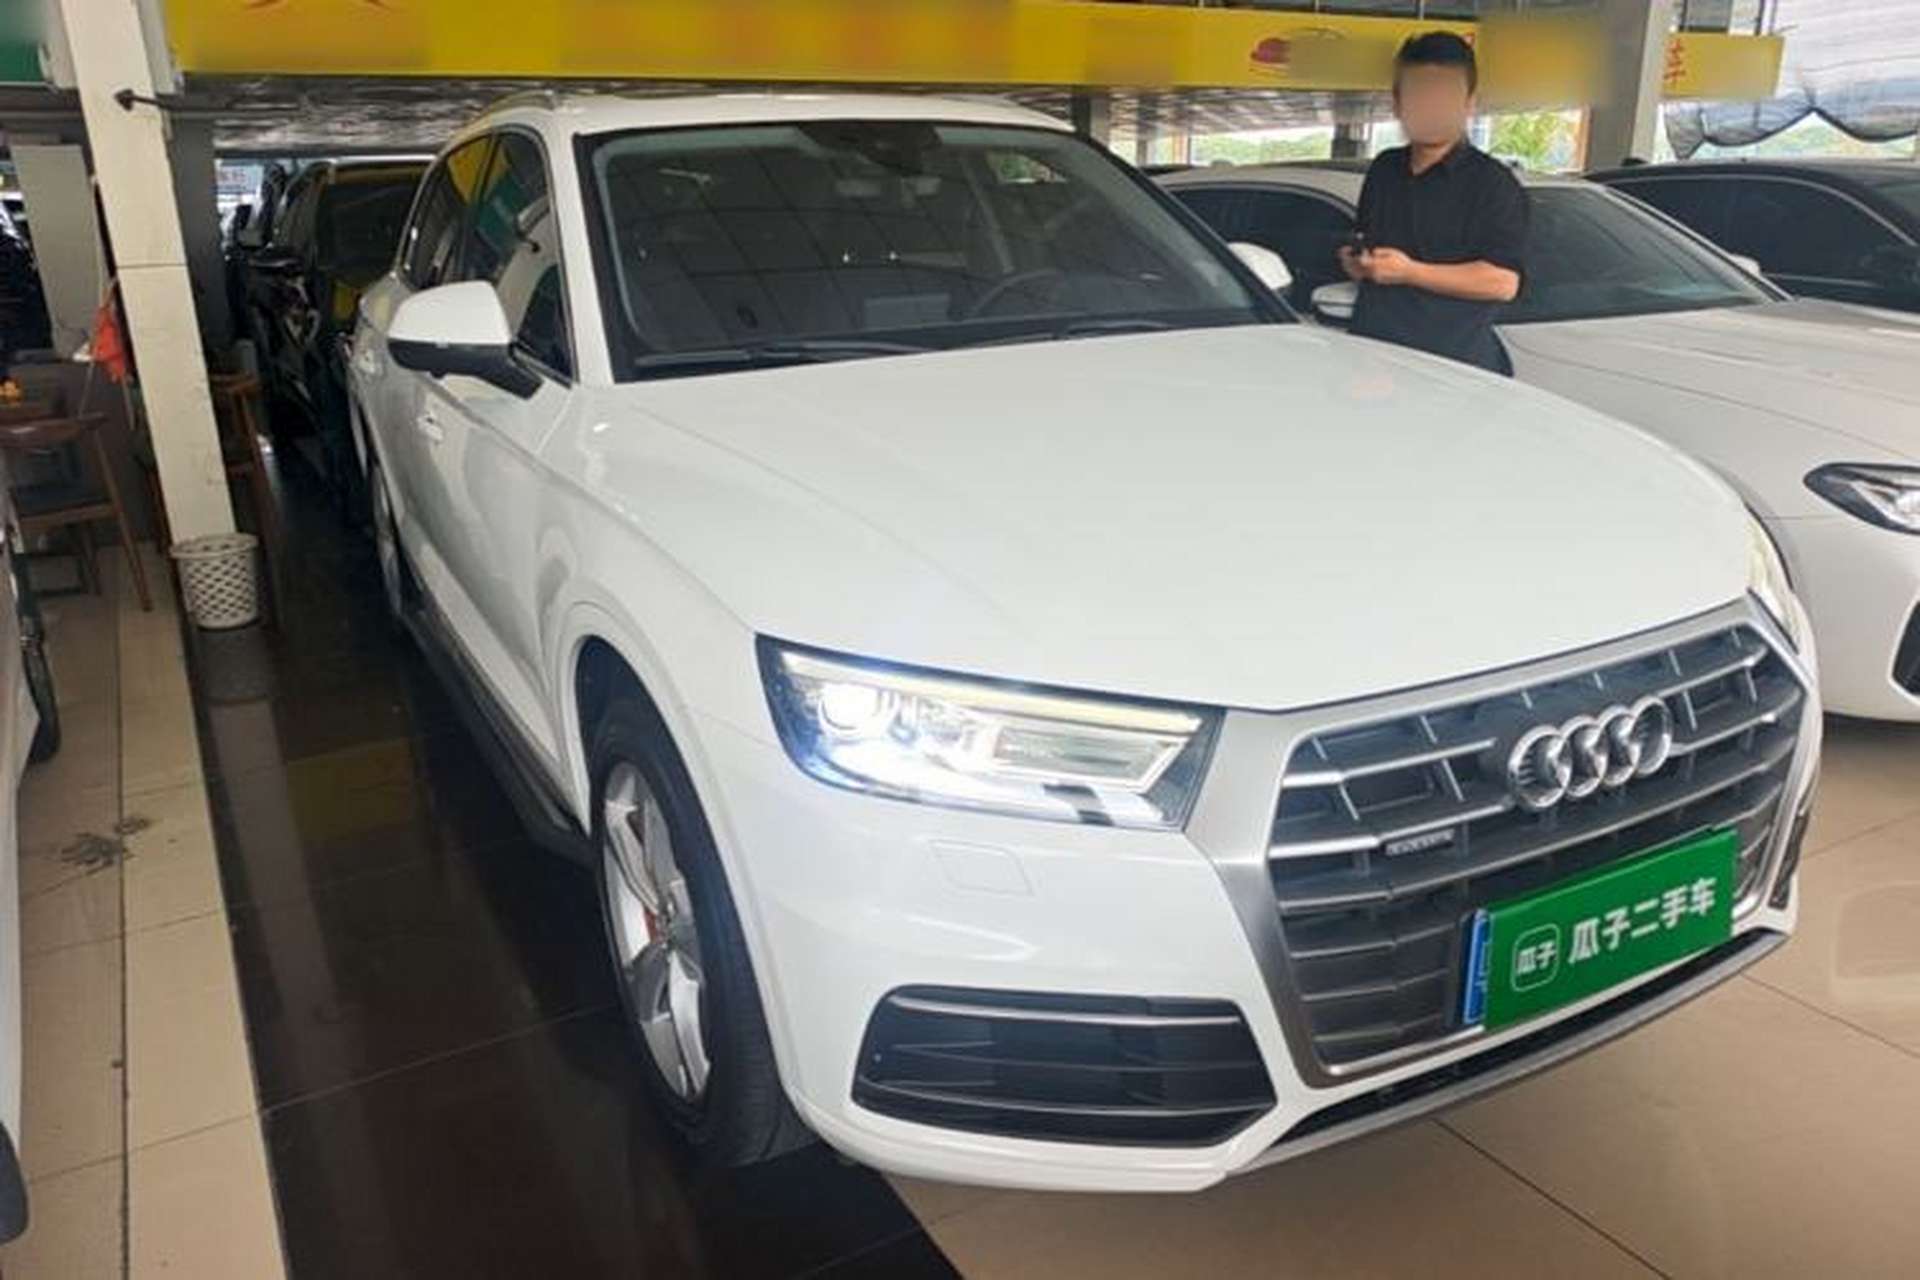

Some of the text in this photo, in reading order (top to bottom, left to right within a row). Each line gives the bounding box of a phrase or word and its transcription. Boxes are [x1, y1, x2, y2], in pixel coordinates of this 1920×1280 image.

[1568, 877, 1717, 965] 瓜子二手车
[1517, 941, 1556, 975] 瓜子
